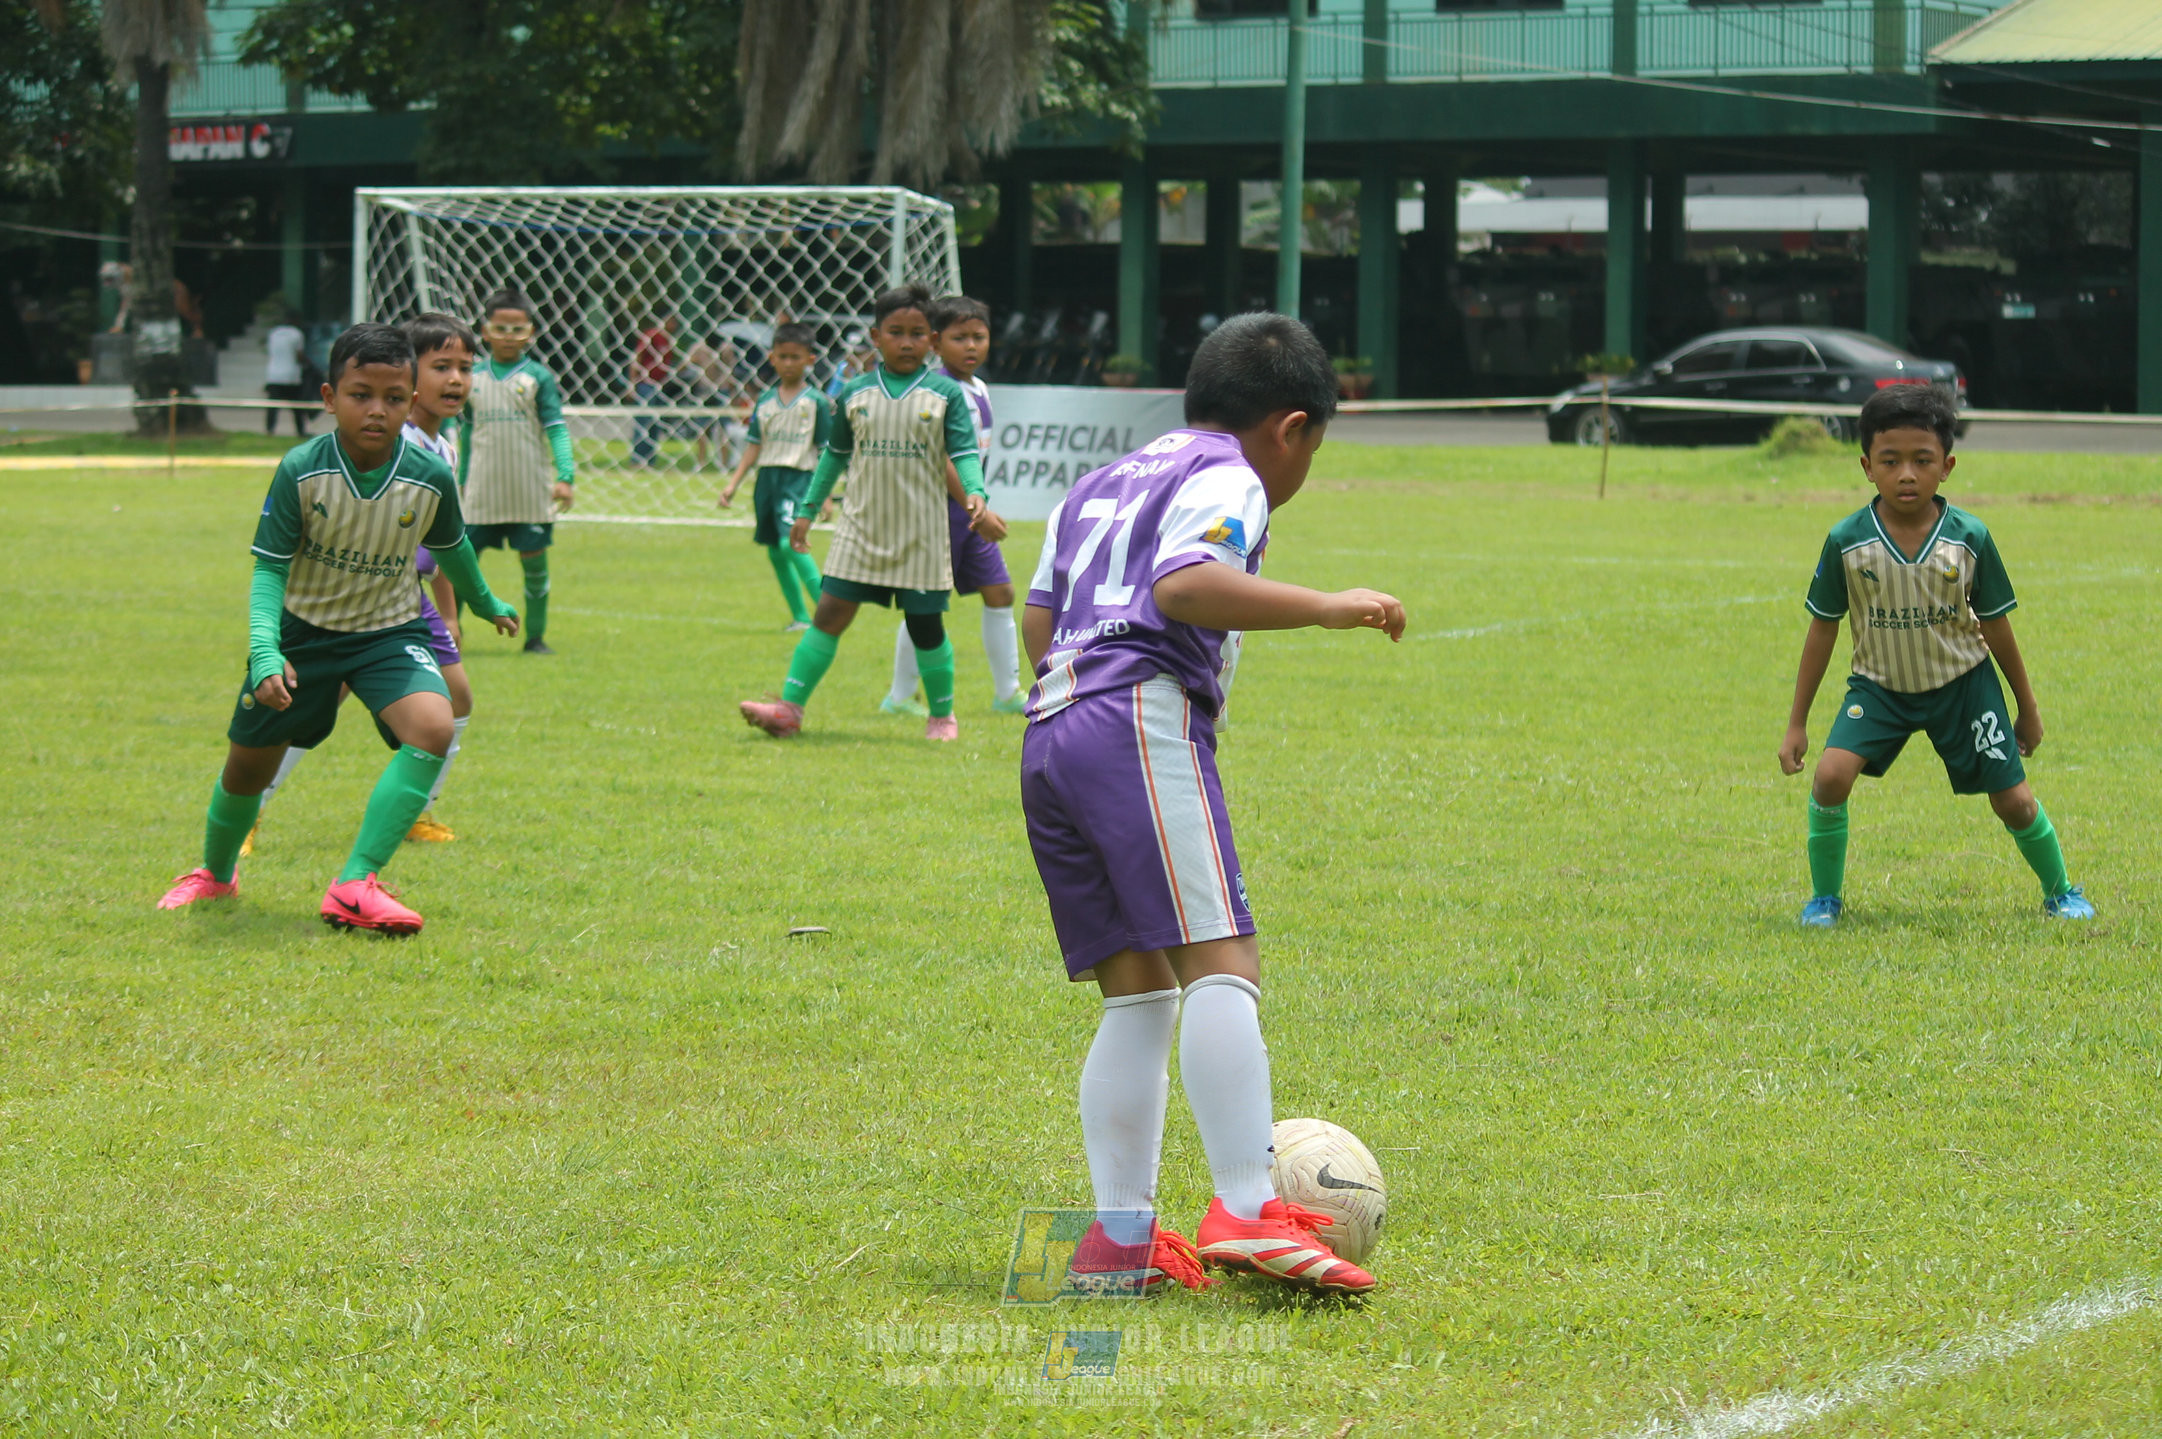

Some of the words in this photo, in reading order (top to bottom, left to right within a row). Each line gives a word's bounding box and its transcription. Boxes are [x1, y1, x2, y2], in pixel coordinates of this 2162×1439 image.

[1000, 423, 1134, 454] OFFICIAL
[987, 459, 1112, 488] APPAR
[1062, 489, 1150, 612] 71
[1971, 710, 2006, 753] 22
